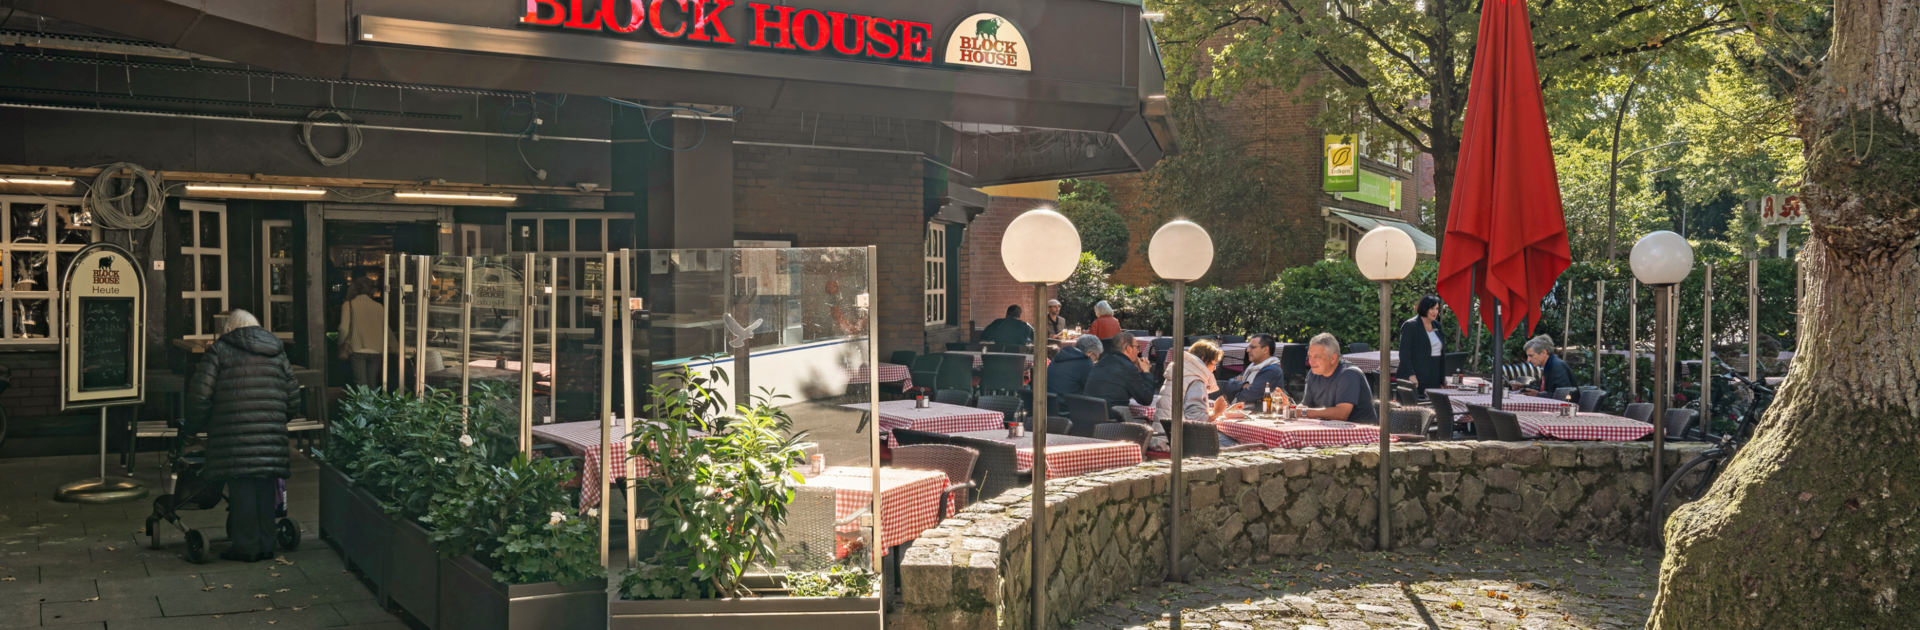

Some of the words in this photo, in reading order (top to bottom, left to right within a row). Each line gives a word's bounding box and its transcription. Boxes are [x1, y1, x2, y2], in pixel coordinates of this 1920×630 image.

[520, 0, 736, 44] BLOCK
[748, 2, 932, 63] HOUSE
[959, 36, 1018, 54] BLOCK
[959, 49, 1018, 67] HOUSE
[92, 277, 120, 285] HOUSE
[92, 286, 120, 294] Heute
